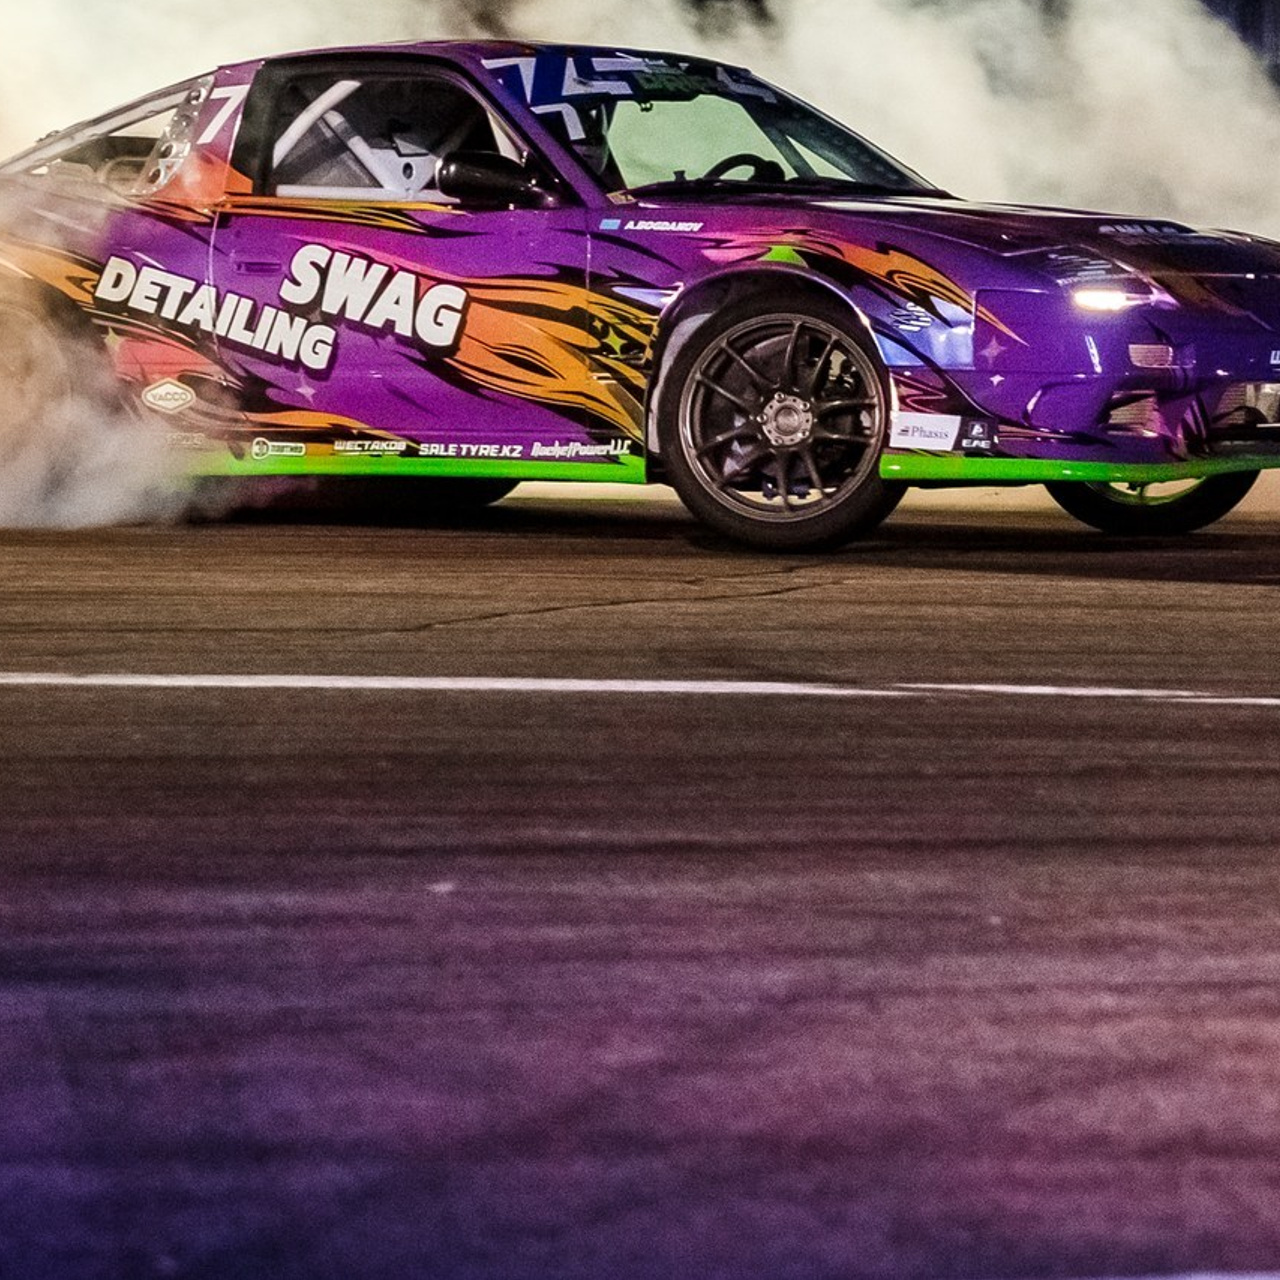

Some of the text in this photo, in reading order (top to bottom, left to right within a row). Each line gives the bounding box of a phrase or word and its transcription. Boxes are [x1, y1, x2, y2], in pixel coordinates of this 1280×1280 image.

[95, 255, 337, 370] DETAILING
[280, 244, 468, 347] SWAG
[911, 425, 950, 439] Phasis
